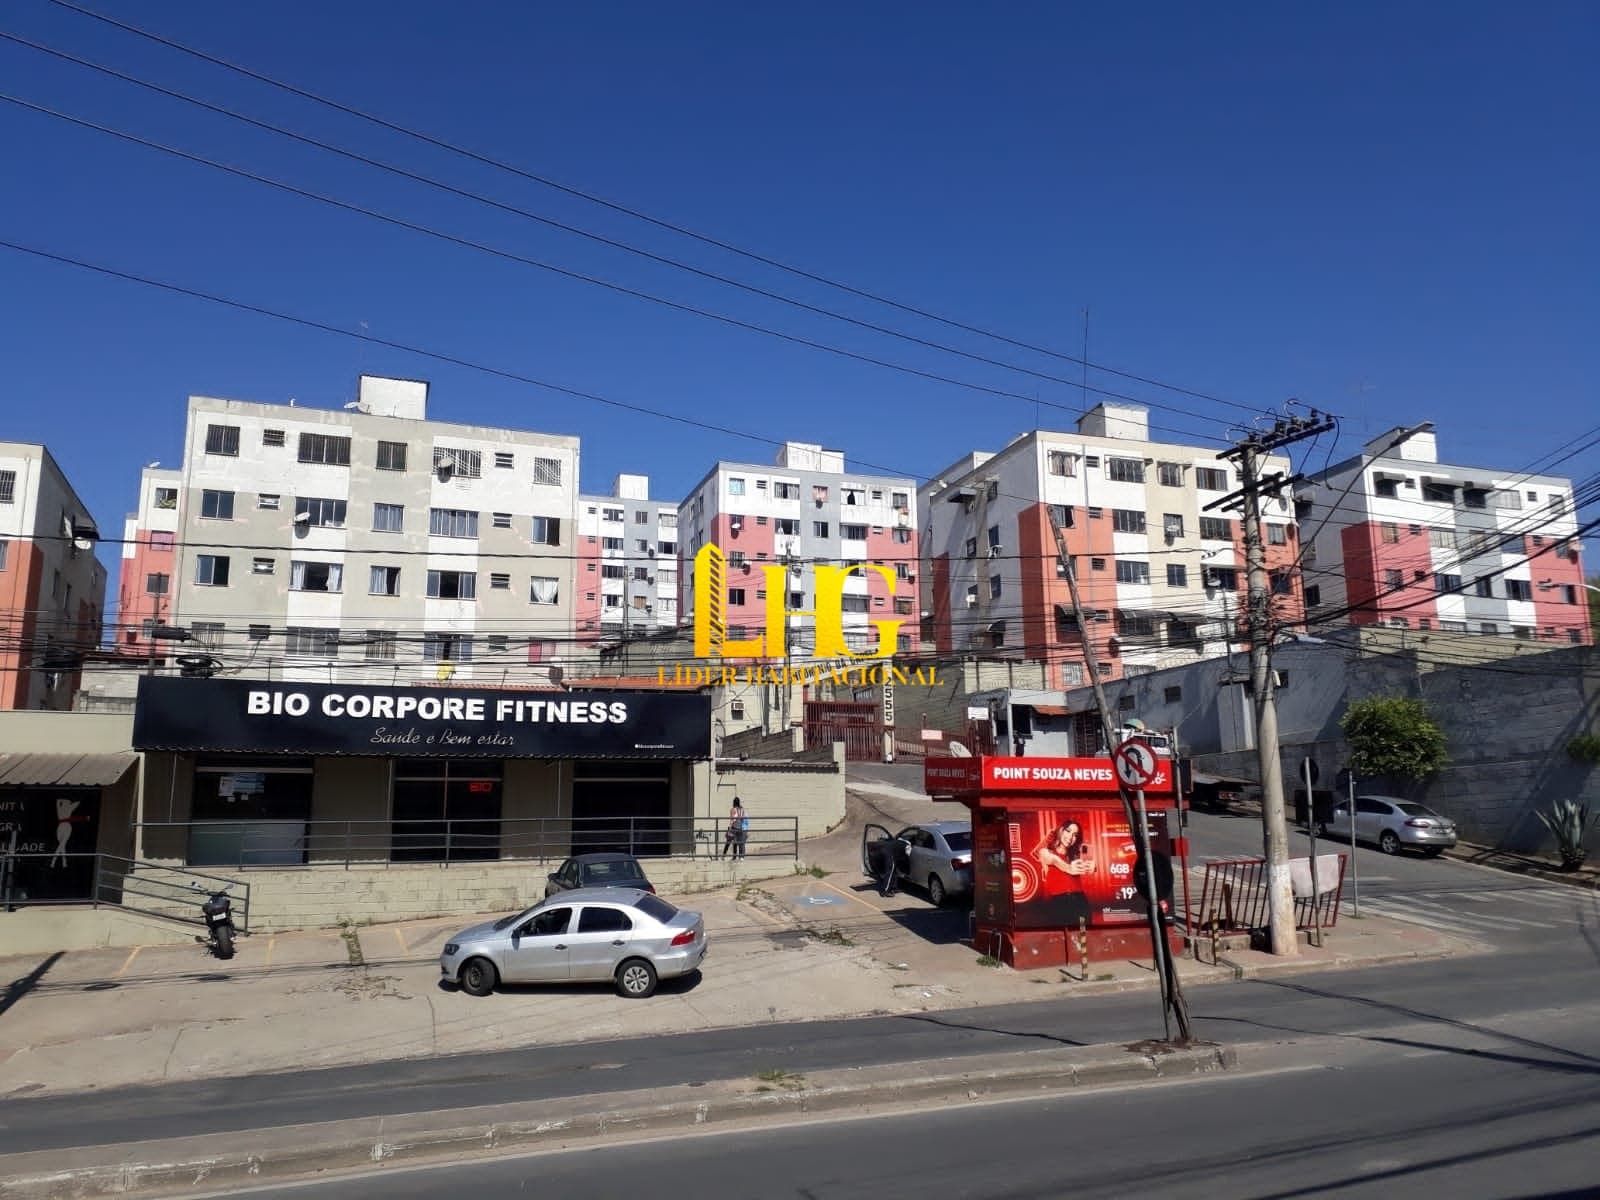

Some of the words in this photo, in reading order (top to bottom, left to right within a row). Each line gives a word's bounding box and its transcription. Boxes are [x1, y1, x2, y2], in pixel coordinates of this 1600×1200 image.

[247, 691, 309, 716] BIO
[321, 694, 486, 721] CORPORE
[496, 699, 627, 723] FITNESS
[884, 677, 893, 721] 2555
[439, 728, 472, 745] Bem
[477, 732, 515, 746] estar
[993, 767, 1031, 780] POINT
[1033, 768, 1071, 780] SOUZA
[1074, 768, 1112, 781] NEVES
[1110, 863, 1129, 874] 6GB
